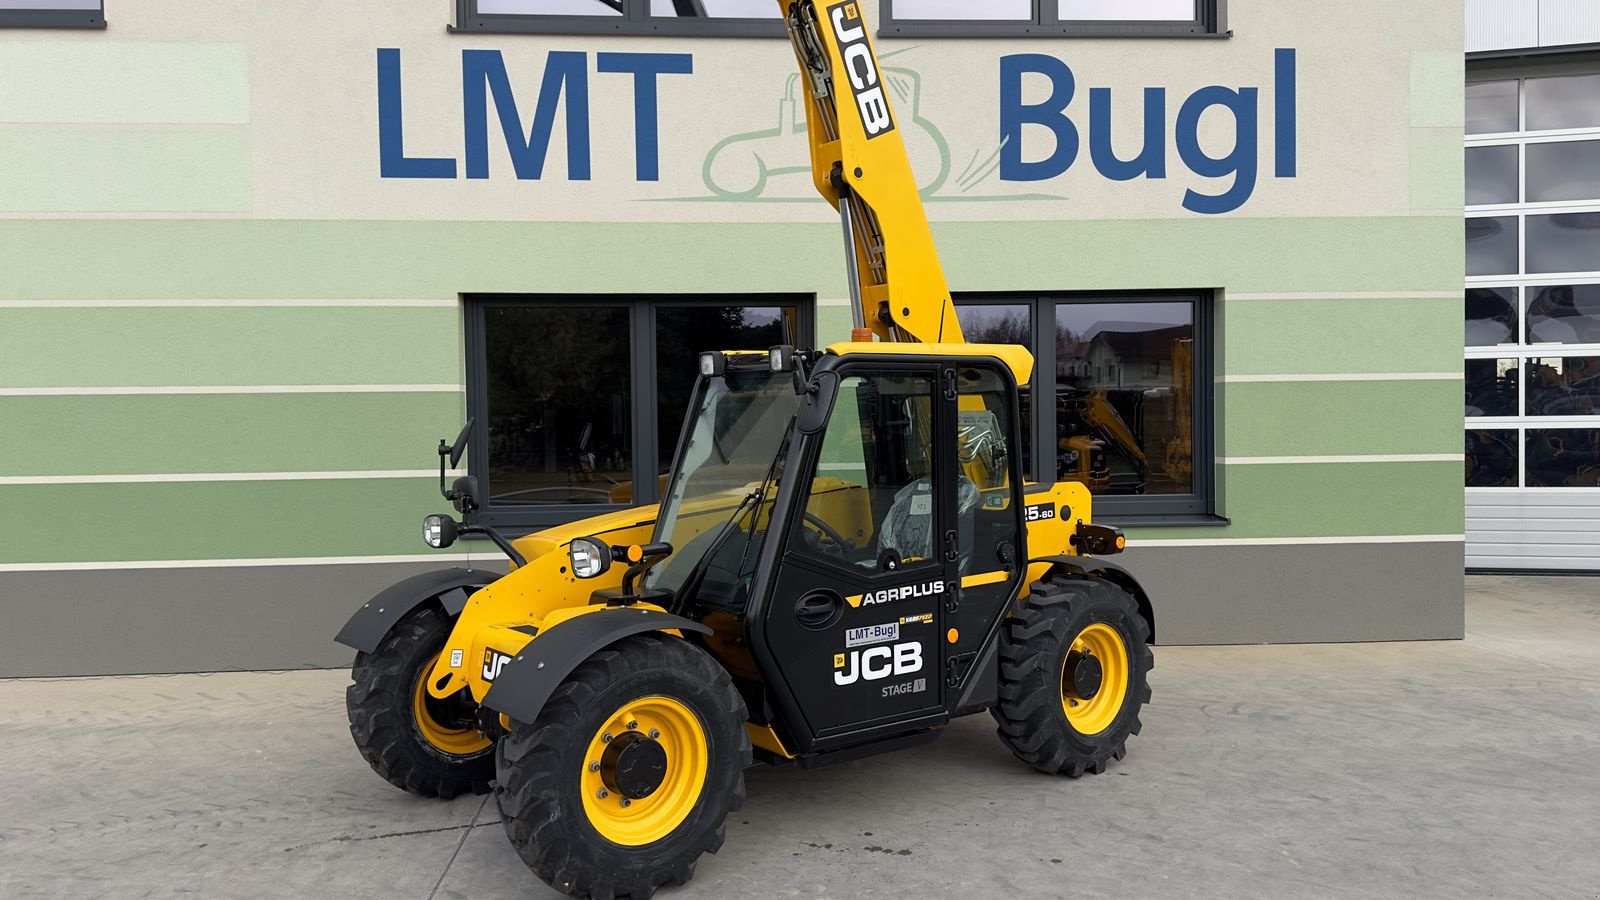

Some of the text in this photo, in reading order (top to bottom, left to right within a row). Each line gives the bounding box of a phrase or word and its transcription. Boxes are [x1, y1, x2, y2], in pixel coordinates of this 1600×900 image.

[831, 6, 890, 135] JCB
[376, 47, 1297, 215] LMT Bugl
[862, 580, 945, 607] AGRIPLUS
[849, 623, 896, 641] LMT-Bugl
[834, 641, 923, 686] JCB
[881, 682, 912, 697] STAGE
